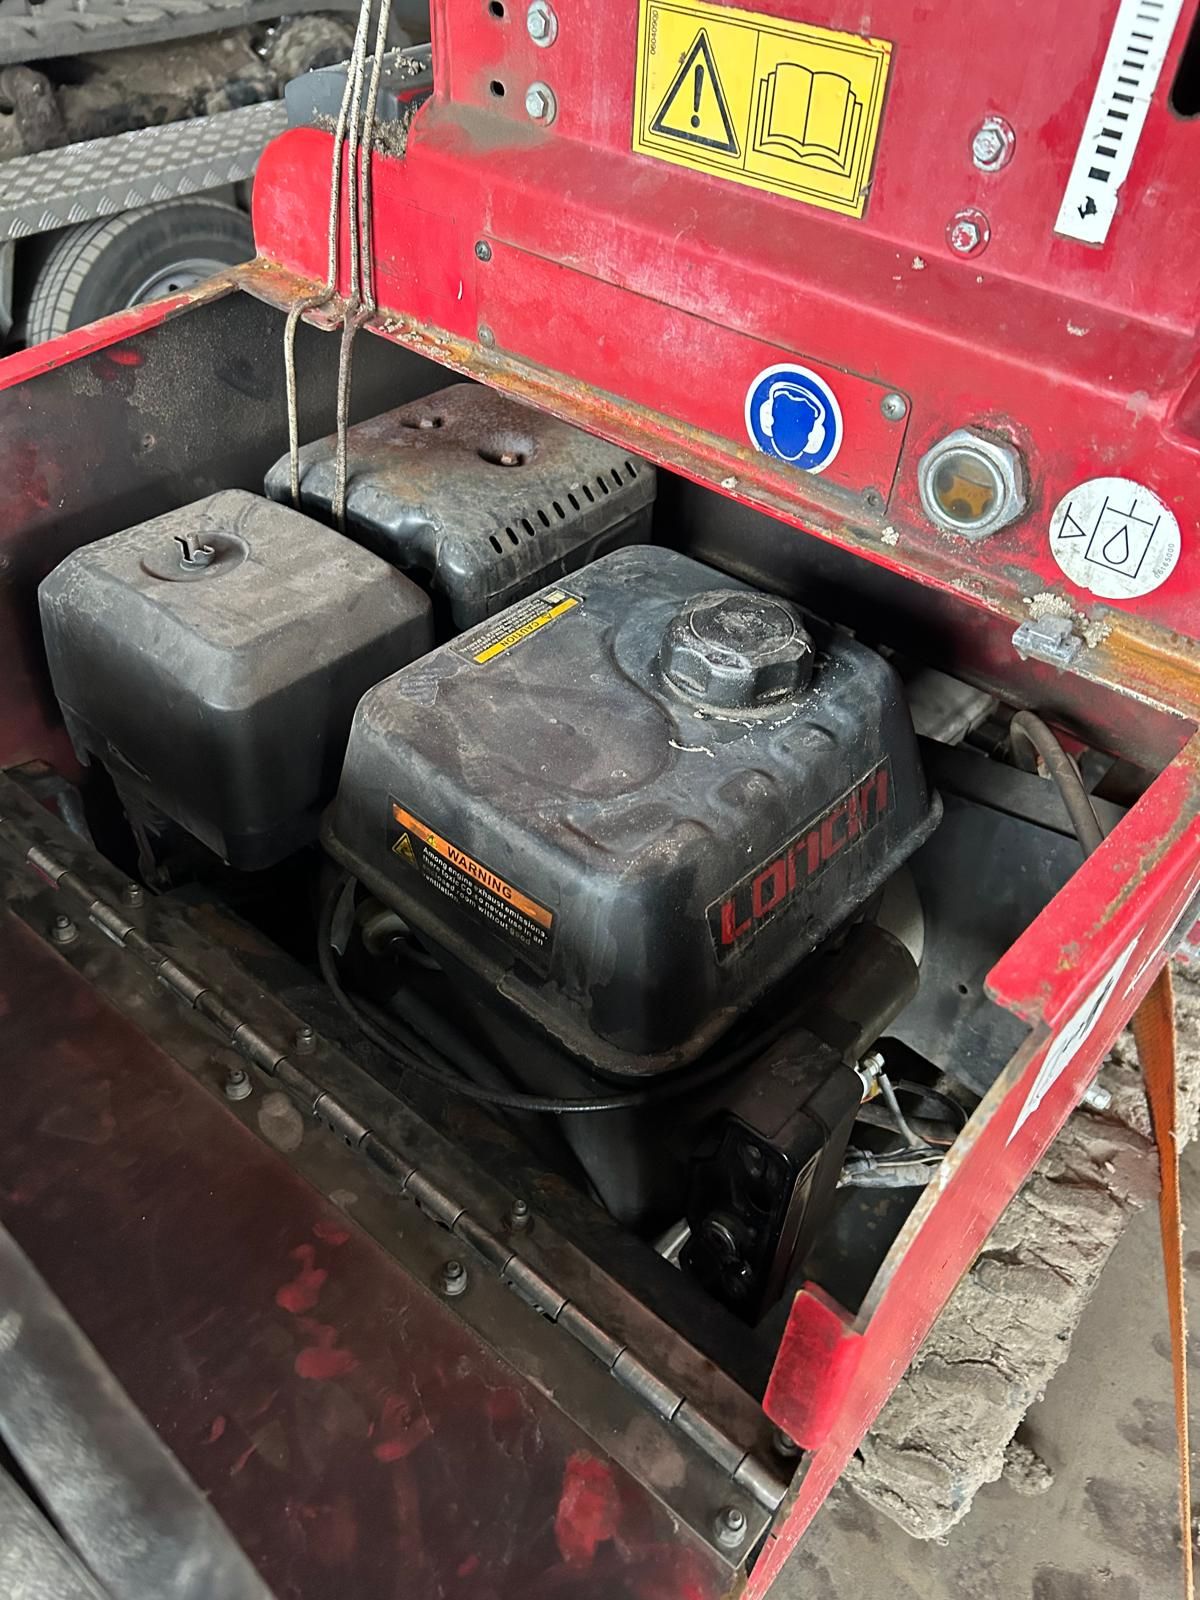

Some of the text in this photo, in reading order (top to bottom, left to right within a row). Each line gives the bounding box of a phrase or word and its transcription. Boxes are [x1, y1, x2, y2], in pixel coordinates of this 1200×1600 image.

[501, 621, 540, 647] CAUTION
[423, 846, 448, 871] Among
[448, 866, 473, 887] engine
[447, 845, 512, 899] WARNING
[422, 854, 441, 872] there
[441, 869, 460, 887] toxic
[485, 901, 507, 920] never
[508, 917, 523, 931] use
[524, 926, 532, 937] in
[533, 934, 544, 946] an
[456, 890, 477, 908] room
[477, 905, 509, 931] without
